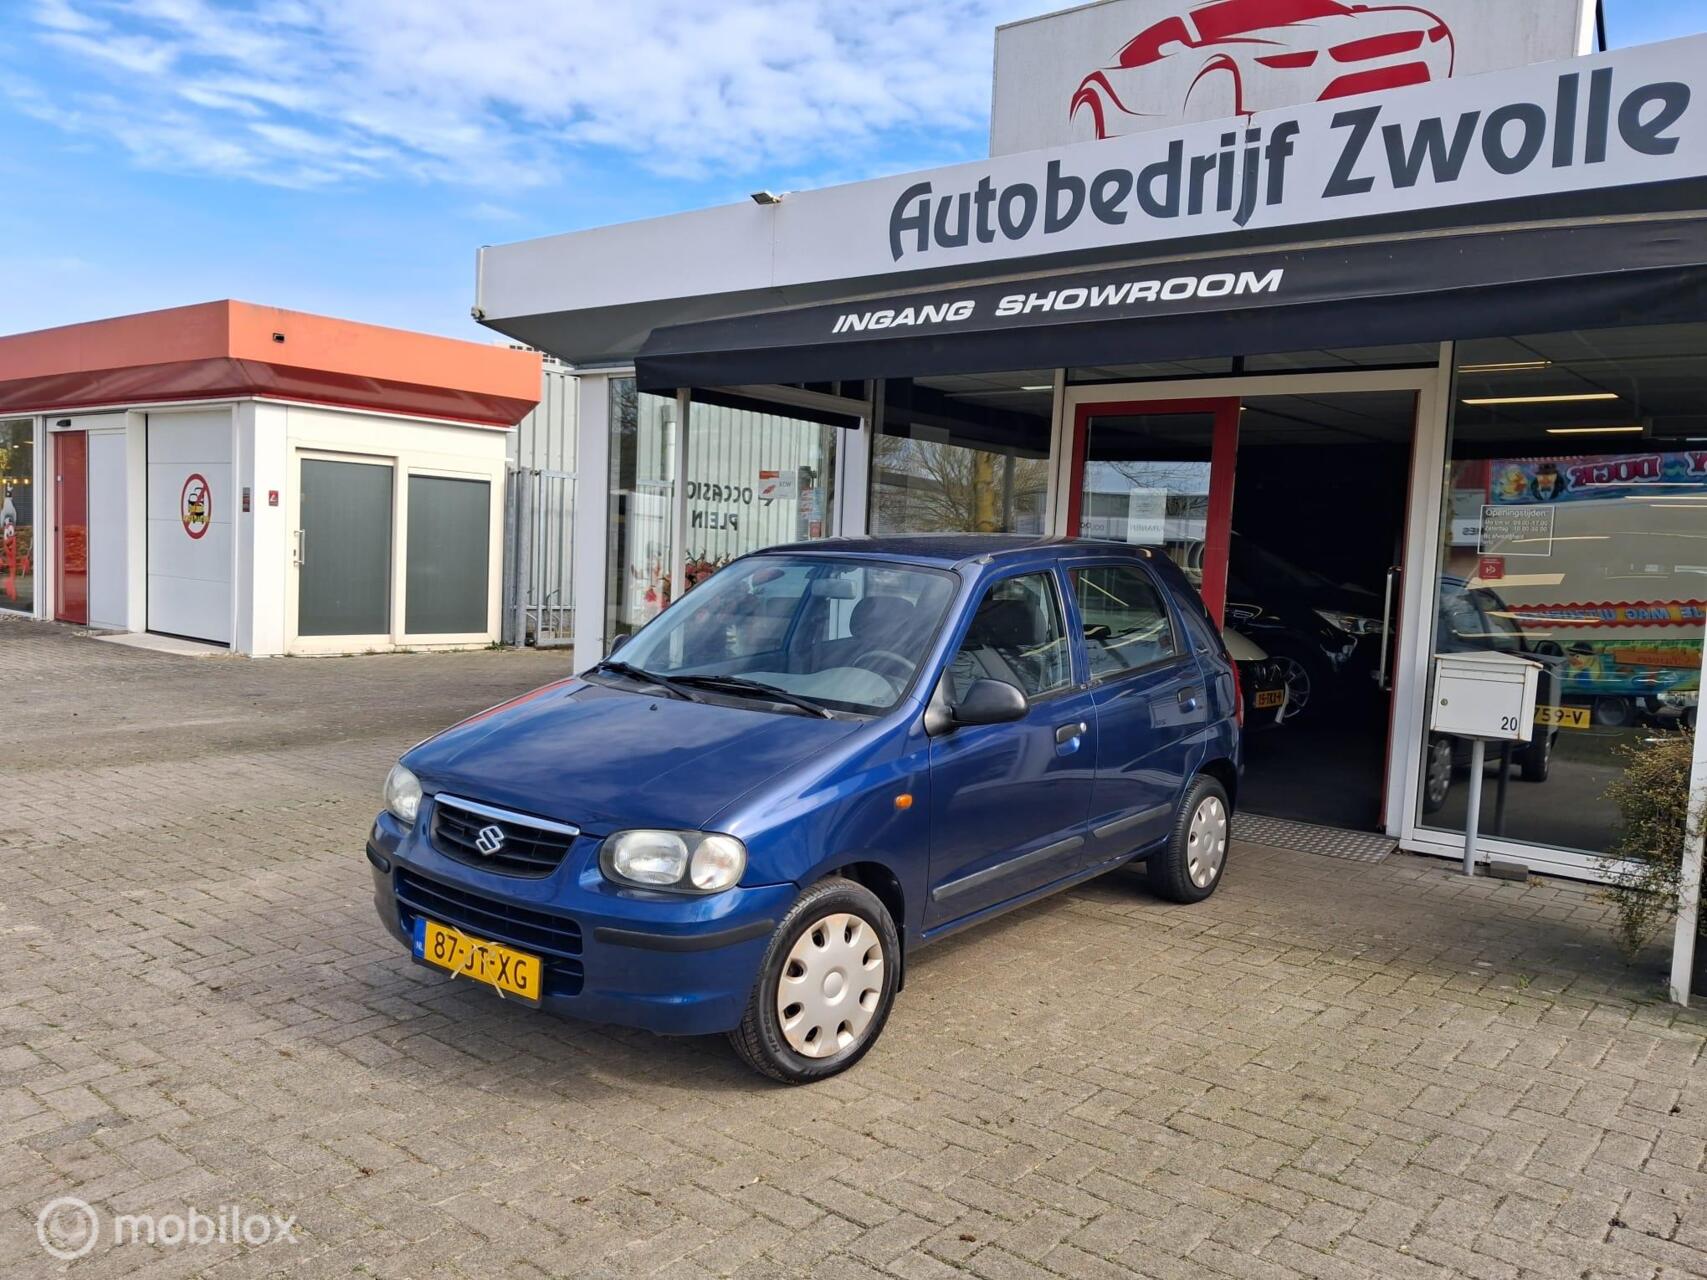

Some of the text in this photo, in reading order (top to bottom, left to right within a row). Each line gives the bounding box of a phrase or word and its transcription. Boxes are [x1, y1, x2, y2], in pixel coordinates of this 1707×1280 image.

[888, 67, 1692, 262] Autobedrijf Zwolle
[832, 269, 1284, 334] INGANG SHOWROOM
[1485, 508, 1547, 518] Openingstijden
[1501, 716, 1517, 731] 20
[434, 931, 527, 989] 87-JT-XG
